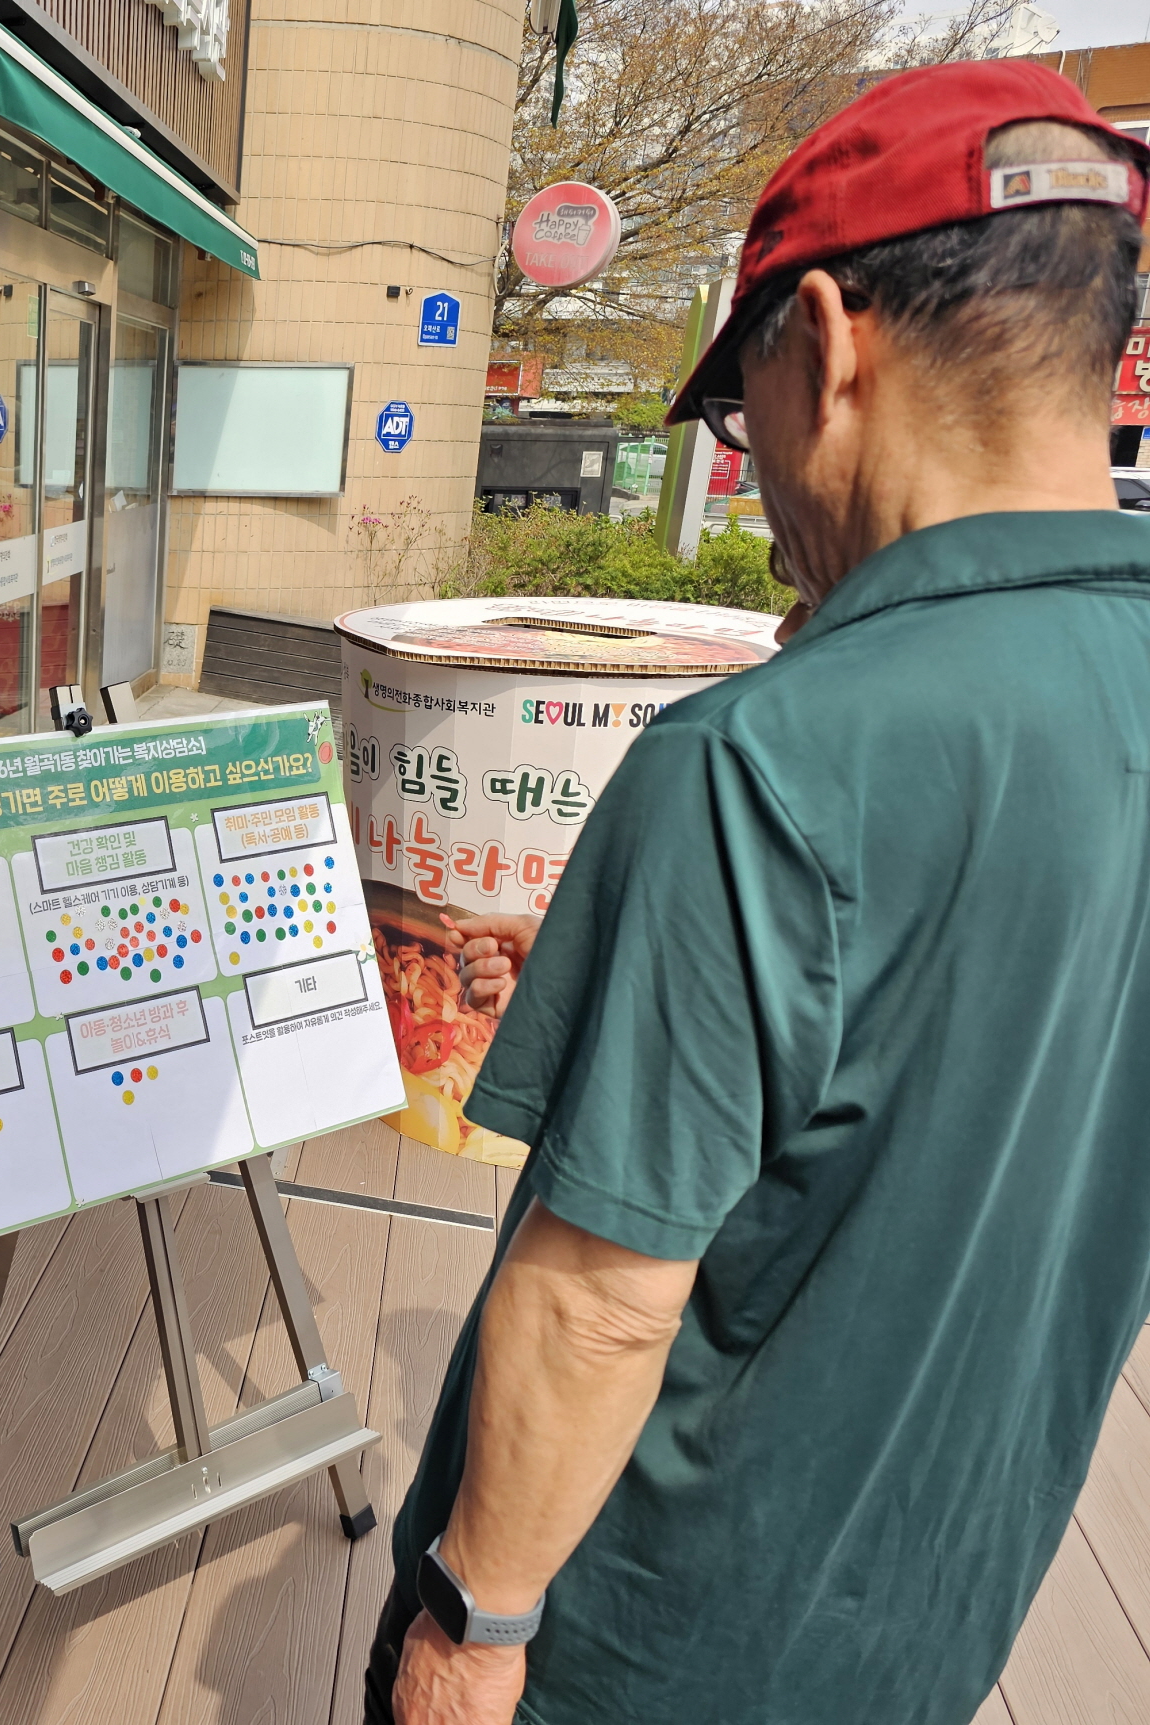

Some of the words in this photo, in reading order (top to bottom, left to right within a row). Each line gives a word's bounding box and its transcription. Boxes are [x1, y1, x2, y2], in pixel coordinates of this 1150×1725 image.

[534, 213, 579, 233] Happy
[535, 229, 577, 242] Coffee
[525, 252, 555, 268] TAKE
[435, 301, 449, 321] 21
[382, 416, 410, 435] ADT
[372, 681, 497, 718] 생명의전화종합사회복지관
[628, 703, 672, 728] SO
[24, 749, 76, 777] 월곡1동
[76, 743, 133, 769] 찾아가는
[133, 737, 207, 761] 복지상담소]
[48, 781, 88, 809] 주로
[90, 771, 148, 804] 어떻게
[151, 764, 223, 796] 이용하고
[225, 752, 313, 785] 싶으신가요?
[393, 750, 460, 812] 힘들
[490, 771, 588, 818] 때는
[273, 807, 296, 826] 모임
[297, 801, 320, 820] 활동
[67, 838, 94, 857] 건강
[95, 834, 121, 852] 확인
[122, 830, 136, 848] 및
[293, 823, 309, 841] 등)
[66, 859, 93, 878] 마음
[94, 854, 119, 874] 챙김
[120, 849, 147, 869] 활동
[28, 898, 61, 916] (스마트
[62, 891, 100, 909] 헬스케어
[101, 887, 118, 904] 기기
[119, 884, 141, 901] 이용,
[177, 875, 190, 890] 등)
[294, 975, 317, 994] 기타
[148, 1004, 175, 1026] 방과
[176, 999, 190, 1017] 후
[241, 1028, 276, 1046] 포스트잇을
[276, 1021, 304, 1037] 활용하여
[304, 1015, 330, 1030] 자유롭게
[344, 1001, 383, 1017] 작성해주세요.
[110, 1027, 172, 1055] 놀이&휴식
